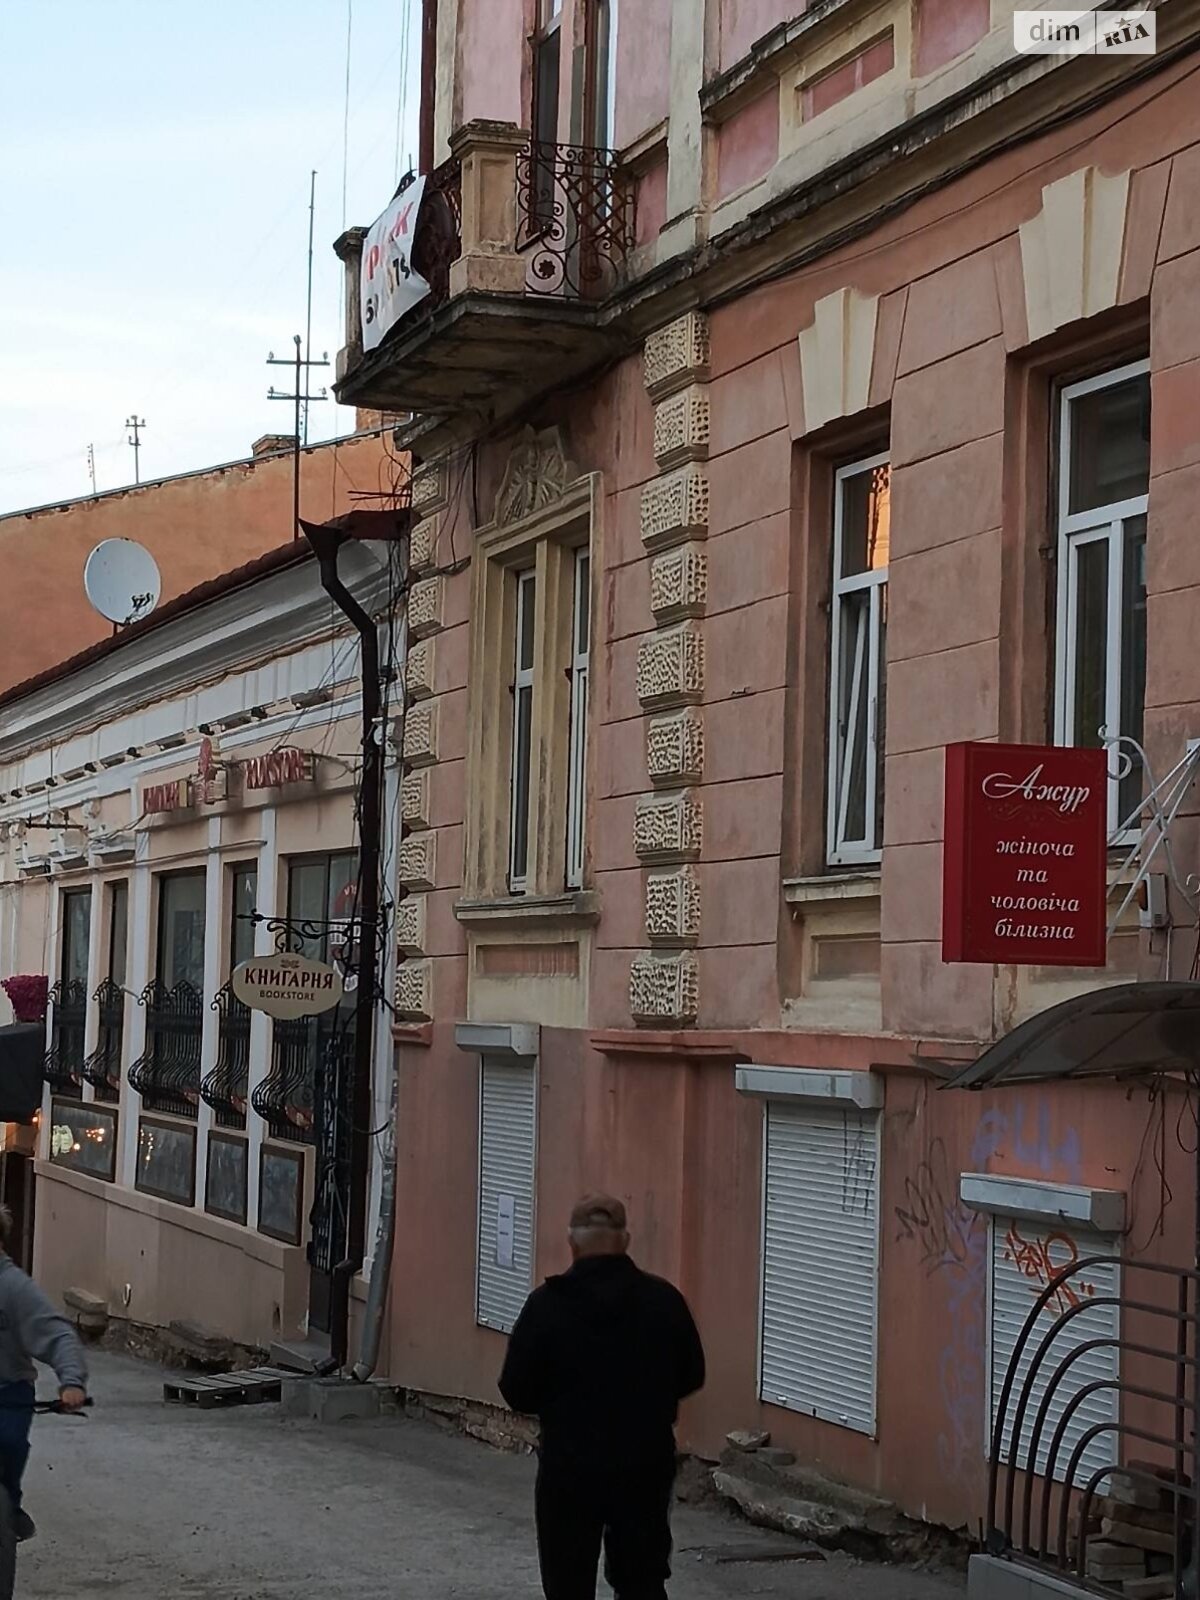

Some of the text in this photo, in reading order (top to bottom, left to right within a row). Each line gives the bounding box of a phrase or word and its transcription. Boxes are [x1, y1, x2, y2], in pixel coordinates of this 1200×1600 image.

[982, 764, 1090, 812] Ажур
[996, 835, 1075, 856] жіноча
[1016, 869, 1048, 883] та
[991, 892, 1080, 912] чоловіча
[994, 918, 1075, 939] білизна
[244, 968, 333, 989] КНИГАРНЯ
[259, 990, 315, 1001] BOOKSTORE
